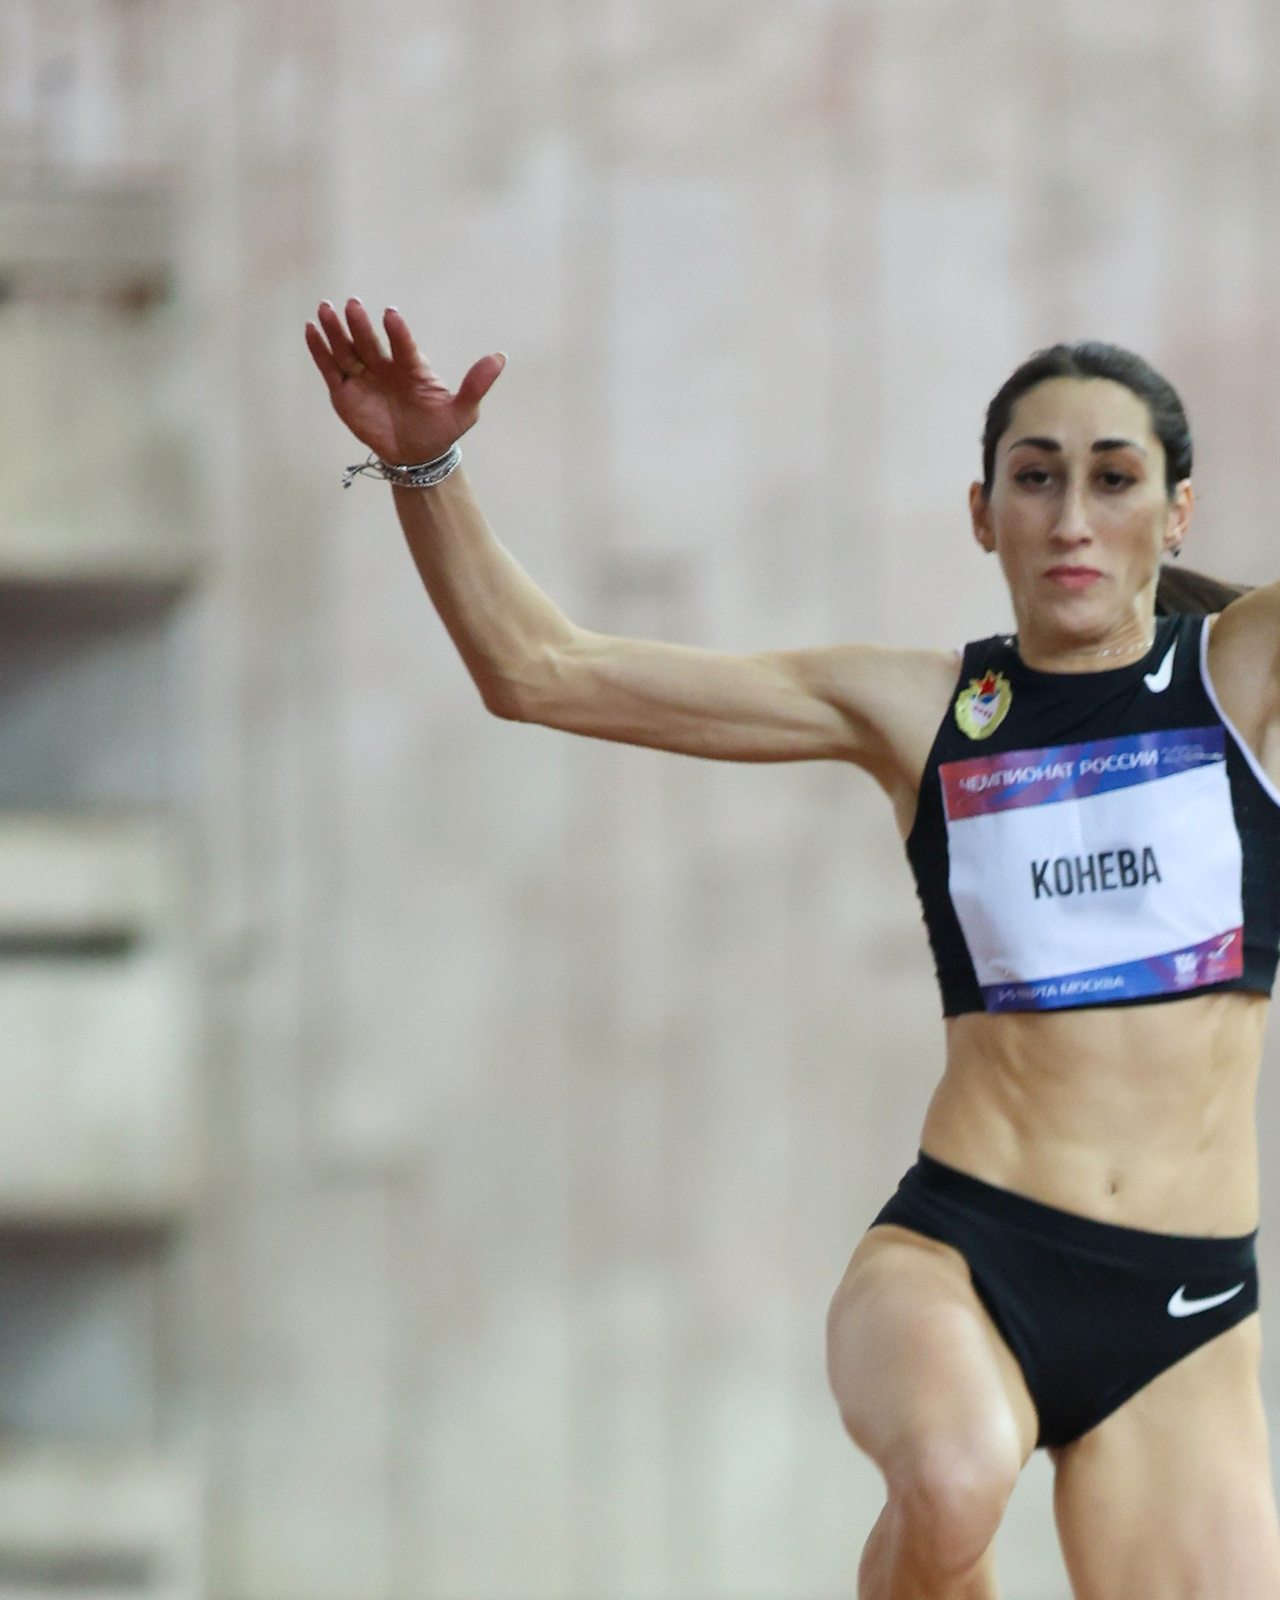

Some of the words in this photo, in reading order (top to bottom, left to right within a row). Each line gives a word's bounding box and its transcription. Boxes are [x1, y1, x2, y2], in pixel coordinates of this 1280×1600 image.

[958, 761, 1074, 793] ЧЕМПИОНАТ
[1079, 749, 1159, 776] РОССИИ
[1031, 847, 1162, 900] КОНЕВА
[1060, 974, 1125, 996] МОСКВА
